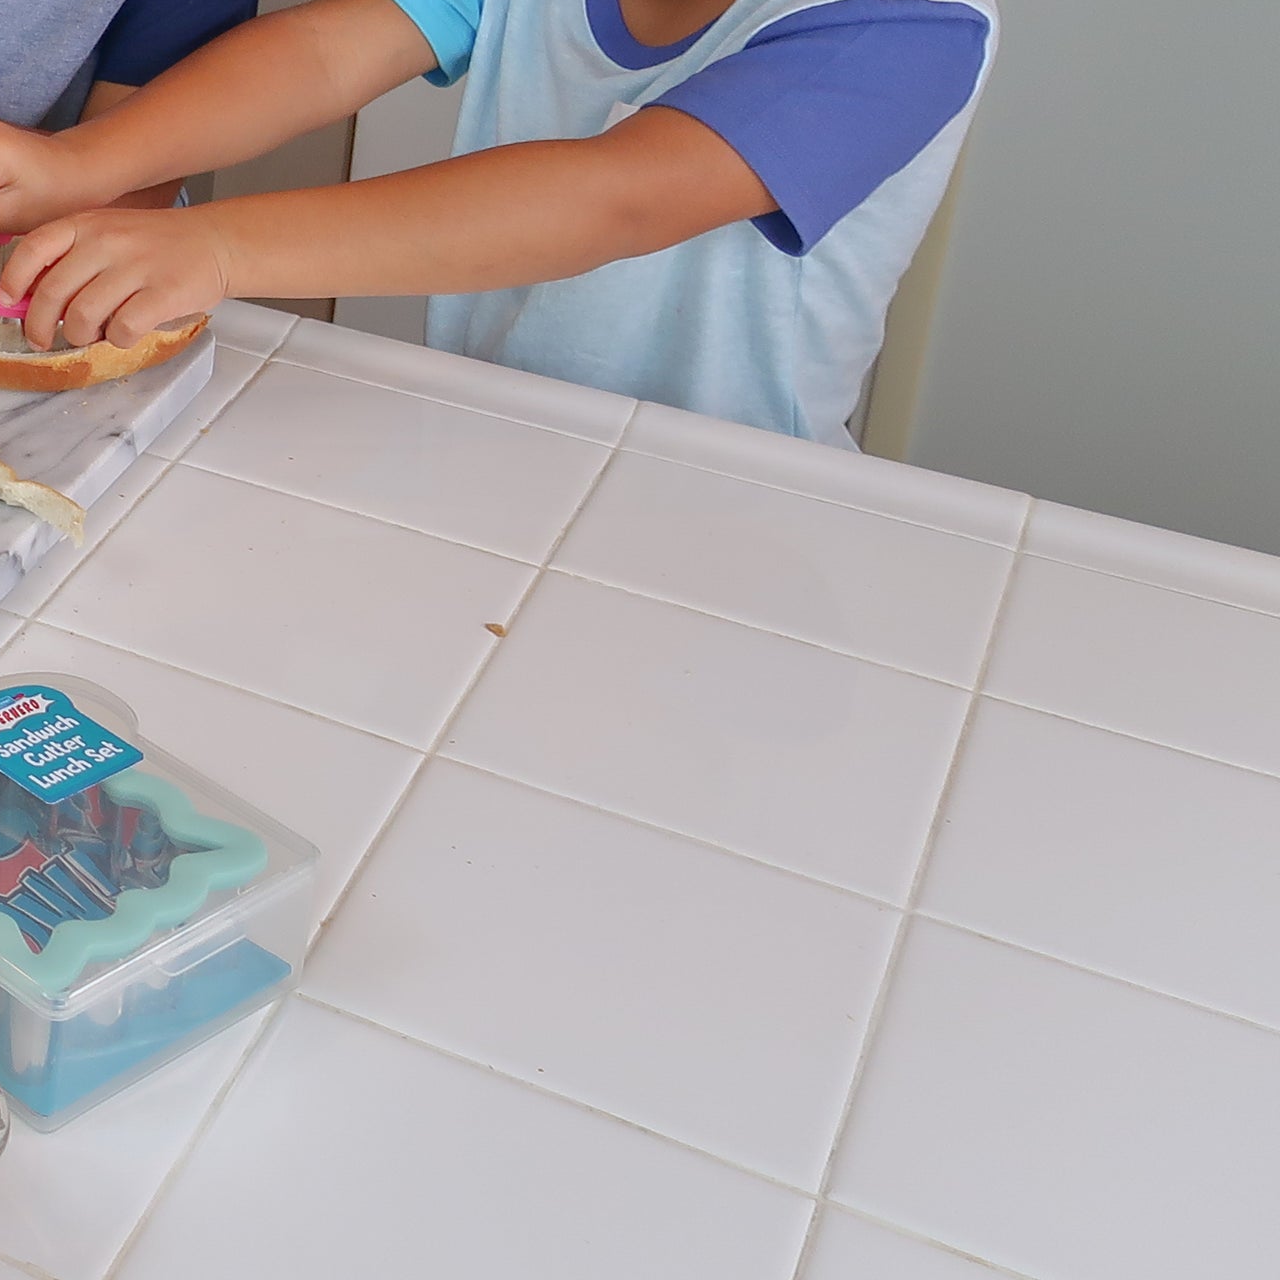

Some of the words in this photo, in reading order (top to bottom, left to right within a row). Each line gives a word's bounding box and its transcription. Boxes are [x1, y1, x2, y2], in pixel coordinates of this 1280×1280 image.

[23, 734, 87, 767] Cutter
[28, 757, 93, 789] Lunch
[84, 740, 124, 763] Set
